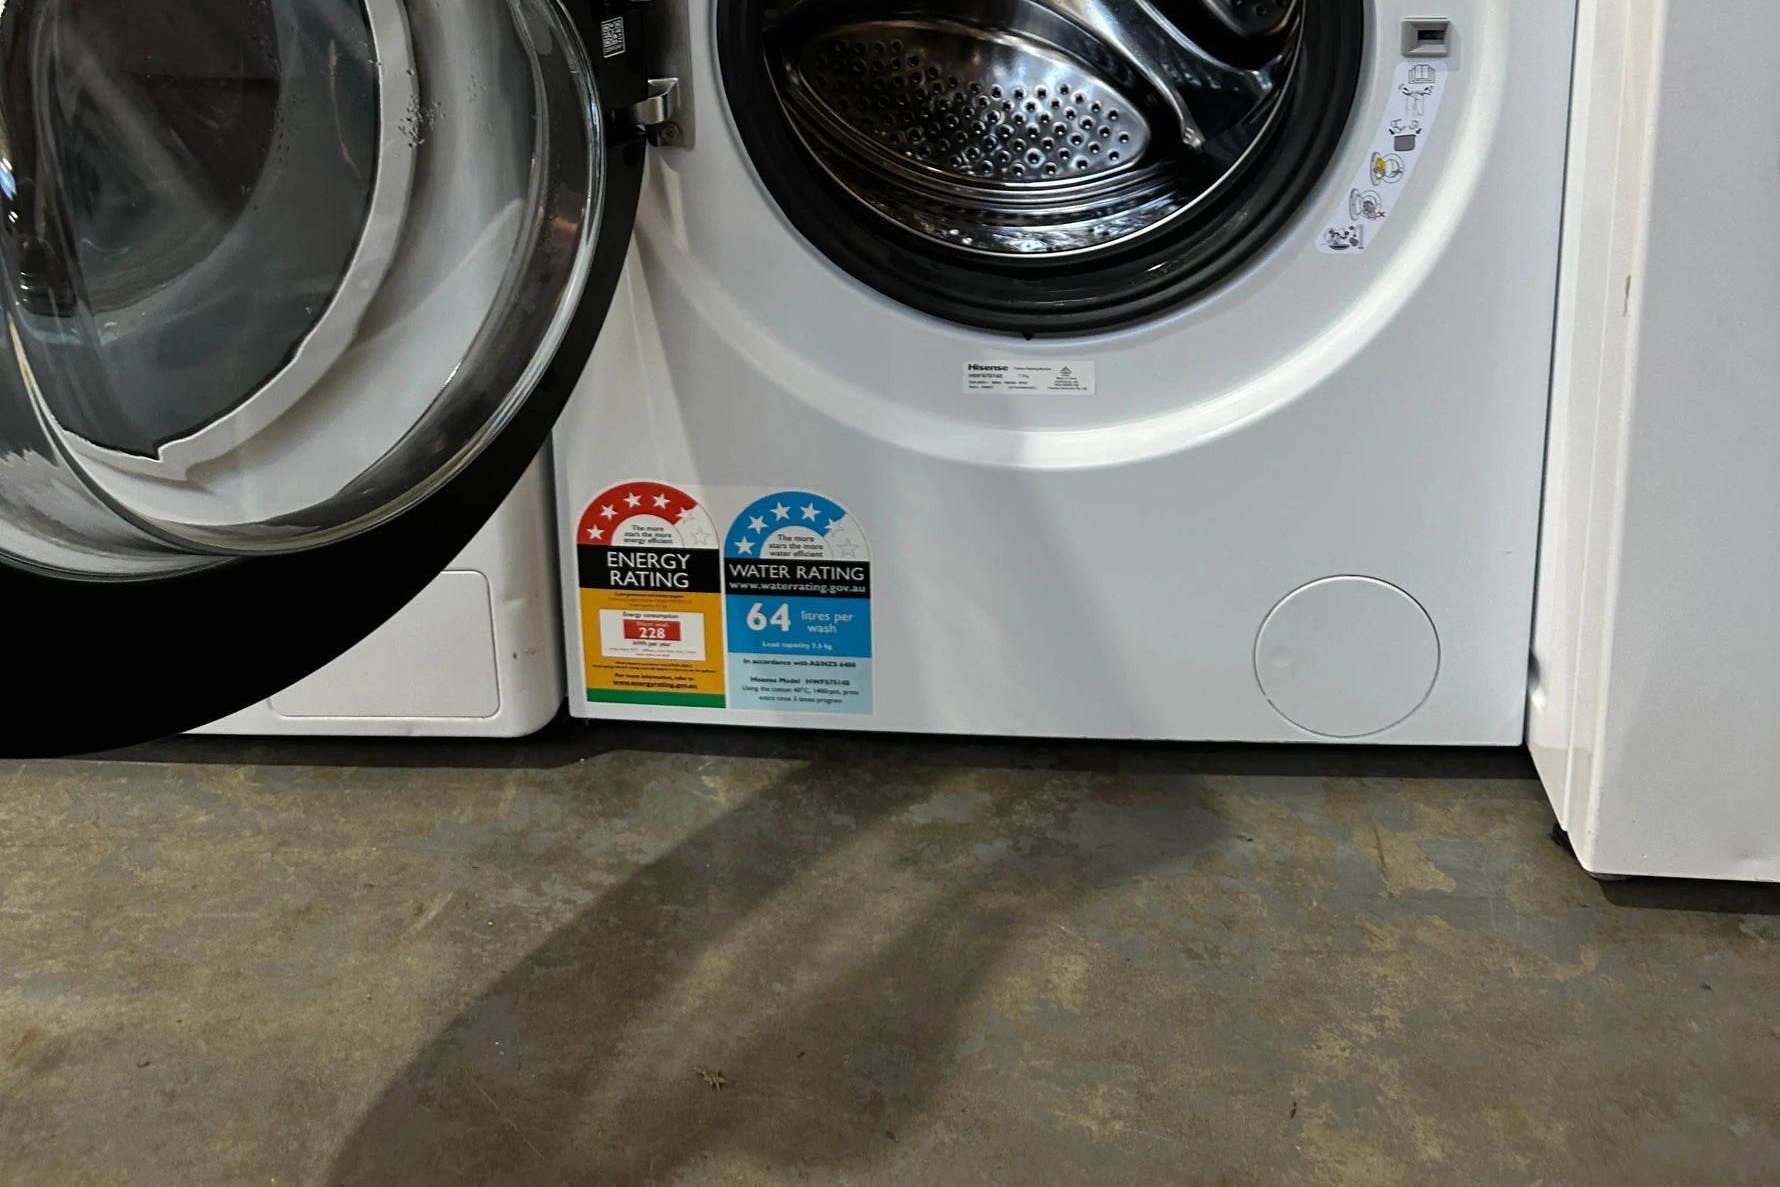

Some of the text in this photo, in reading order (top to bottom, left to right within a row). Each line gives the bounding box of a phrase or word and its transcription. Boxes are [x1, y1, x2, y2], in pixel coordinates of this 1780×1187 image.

[968, 363, 1009, 371] Hisense
[777, 534, 793, 542] The
[607, 551, 691, 570] ENERGY
[729, 564, 865, 581] WATER RATING
[610, 570, 690, 589] RATING
[729, 581, 866, 594] www.waterrating.gov.au
[746, 602, 792, 632] 64
[801, 610, 854, 624] litres per
[639, 626, 666, 639] 228
[807, 624, 837, 633] wash
